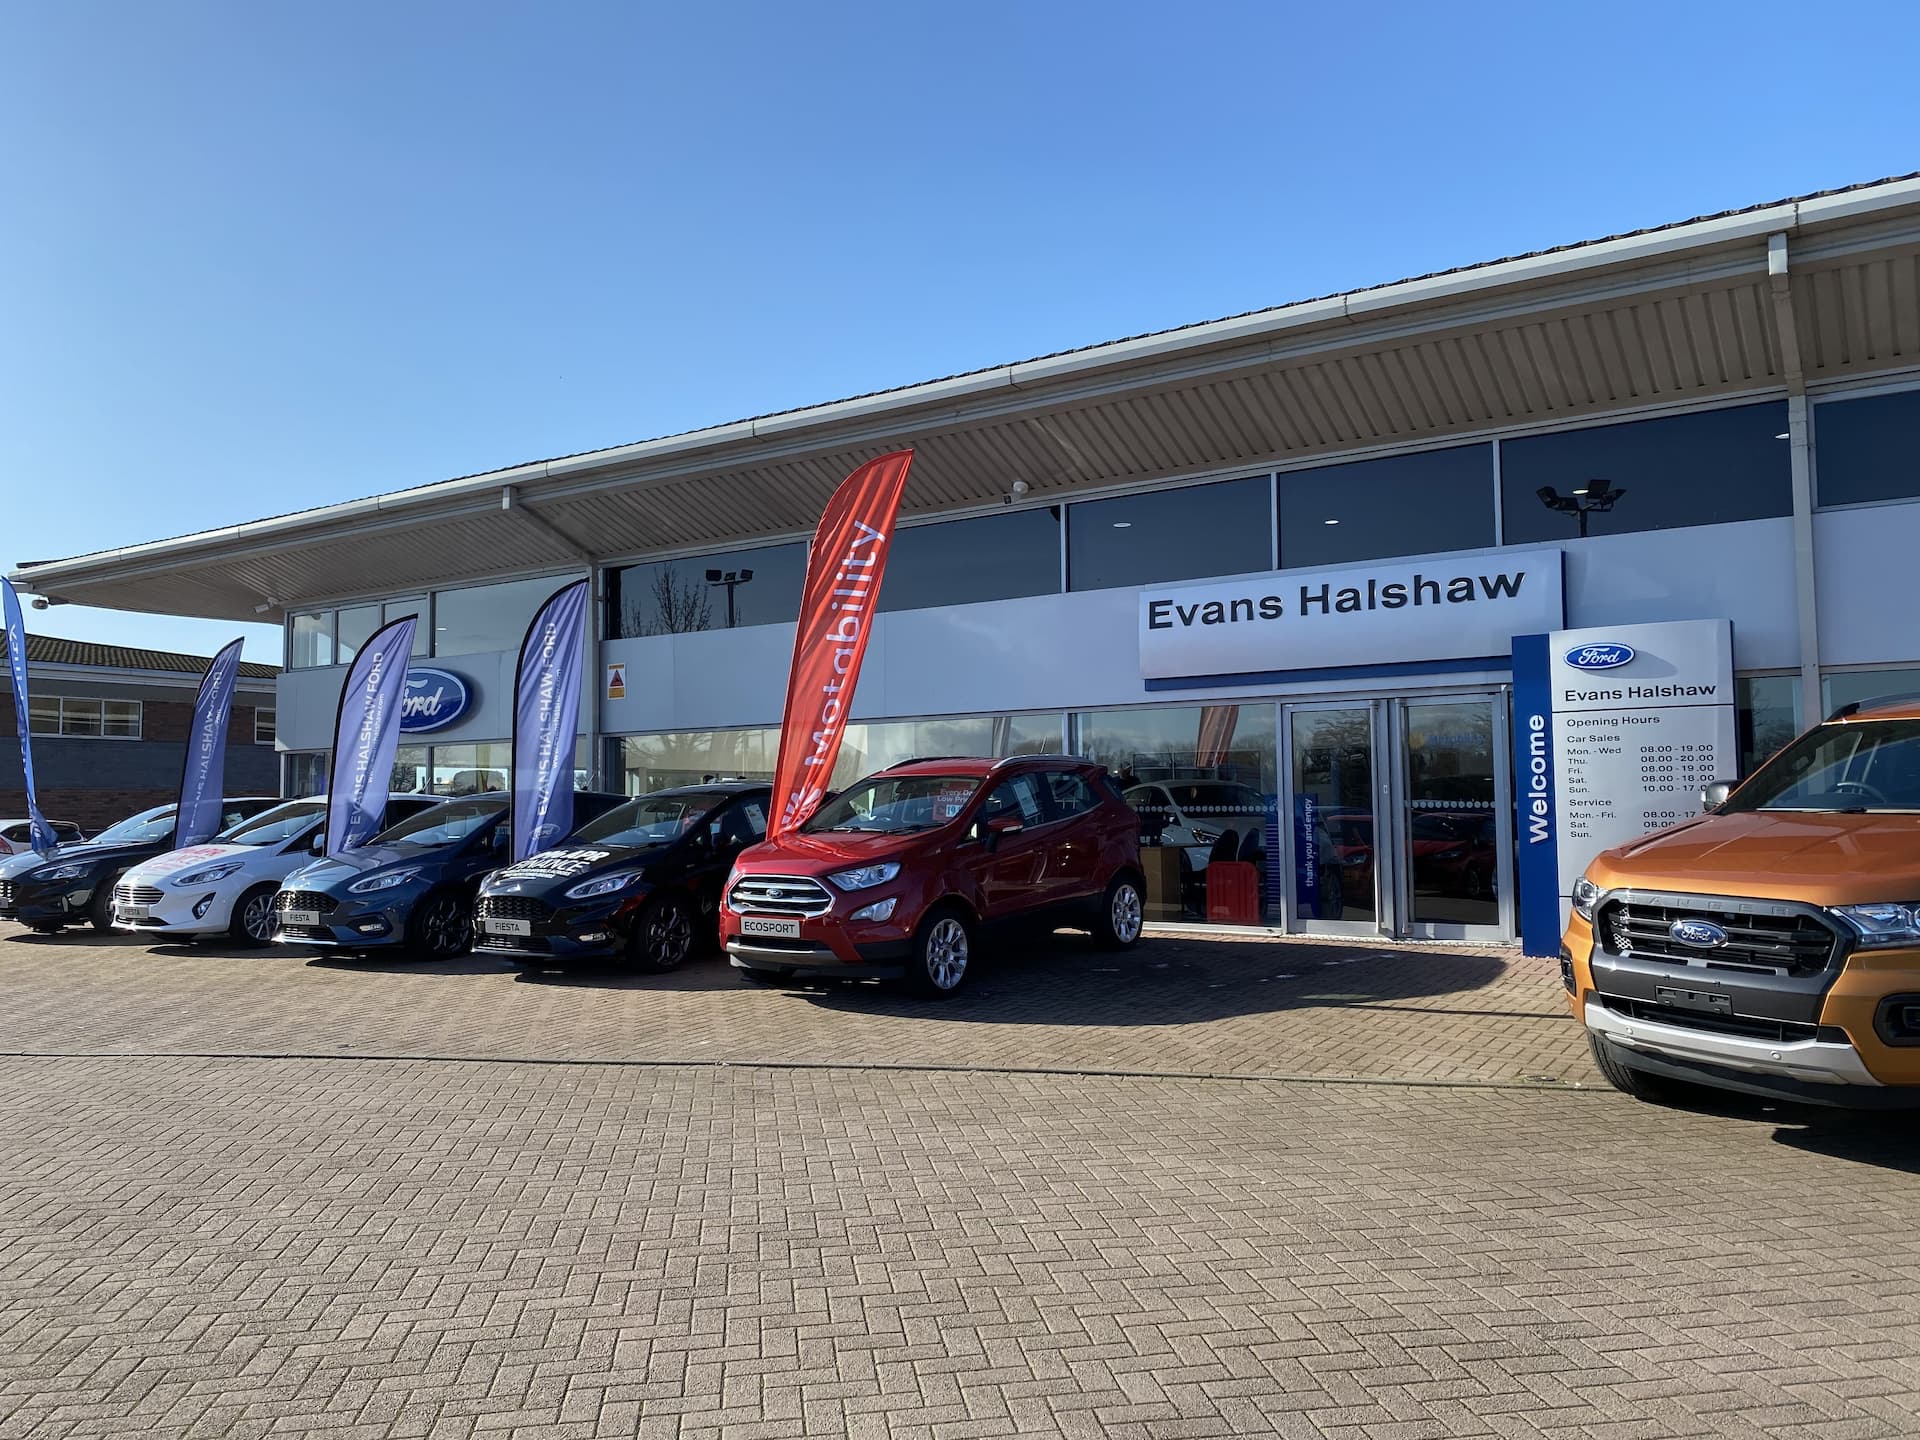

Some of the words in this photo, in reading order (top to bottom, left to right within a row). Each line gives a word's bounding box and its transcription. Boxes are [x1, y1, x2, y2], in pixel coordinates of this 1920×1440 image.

[1149, 594, 1283, 629] Evans
[1299, 571, 1527, 616] Halshaw
[543, 622, 557, 668] FORD
[805, 519, 886, 766] Motability
[1578, 647, 1621, 665] Ford
[367, 651, 384, 693] FORD
[1565, 689, 1623, 702] Evans
[1628, 684, 1717, 699] Halshaw
[540, 672, 554, 757] HALSHAW
[1567, 717, 1618, 728] Opening
[1622, 715, 1661, 726] Hours
[356, 698, 375, 771] HALSHAW
[1567, 735, 1586, 744] Car
[1589, 734, 1621, 743] Sales
[1567, 747, 1591, 755] Mon.
[1599, 747, 1622, 755] Wed
[1528, 714, 1550, 844] Welcome
[1568, 767, 1583, 775] Fri.
[537, 758, 550, 817] EVANS
[350, 774, 364, 825] EVANS
[1569, 799, 1612, 807] Service
[1305, 798, 1313, 823] enjoy
[1569, 811, 1595, 819] Mon.
[1601, 811, 1616, 819] Fri.
[1303, 823, 1313, 841] and
[1306, 842, 1314, 859] you
[1304, 860, 1314, 887] thank
[289, 913, 311, 923] FIESTA
[495, 921, 520, 932] FIESTA
[744, 920, 795, 934] ECOSPORT
